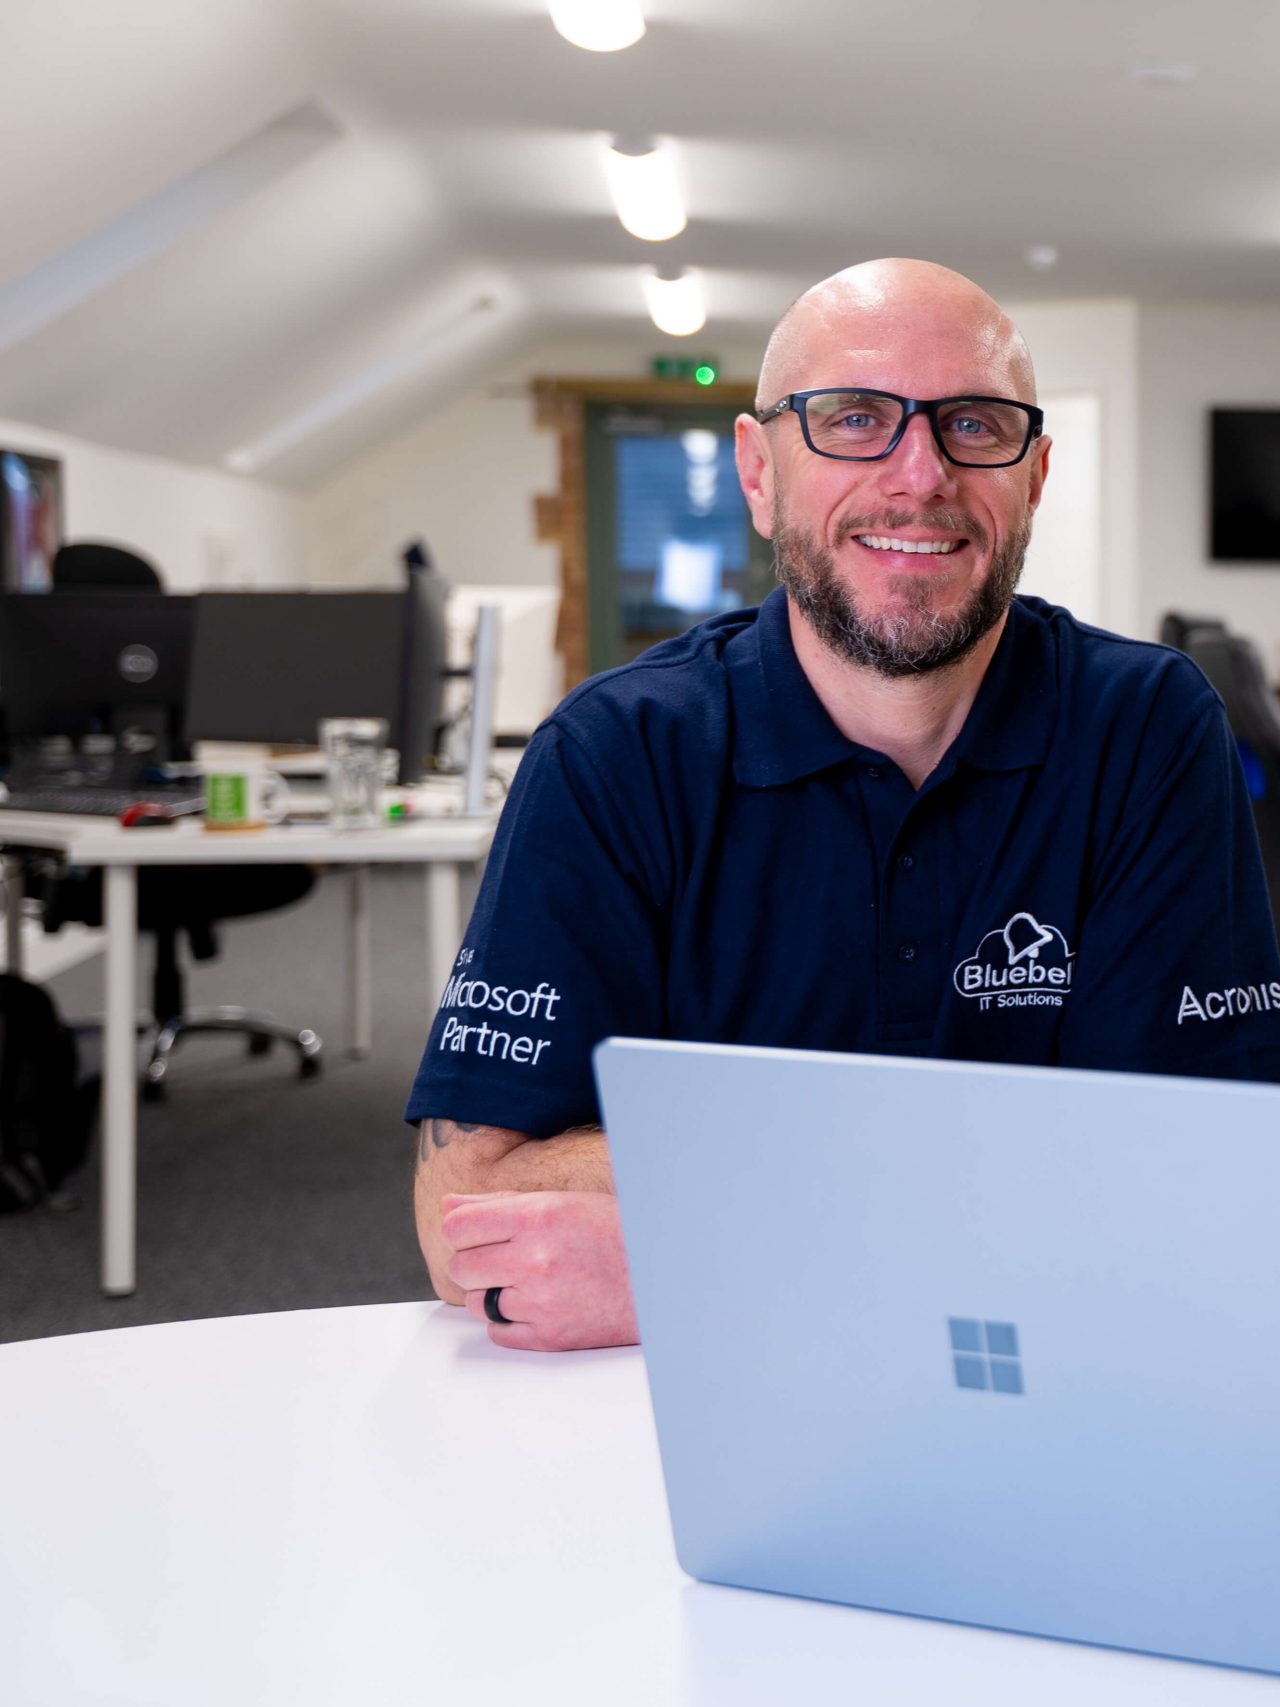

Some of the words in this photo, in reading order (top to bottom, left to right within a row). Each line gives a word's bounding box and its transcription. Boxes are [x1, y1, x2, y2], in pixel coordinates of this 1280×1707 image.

[980, 996, 994, 1011] IT
[997, 992, 1064, 1008] Solutions
[439, 1016, 552, 1066] Partner
